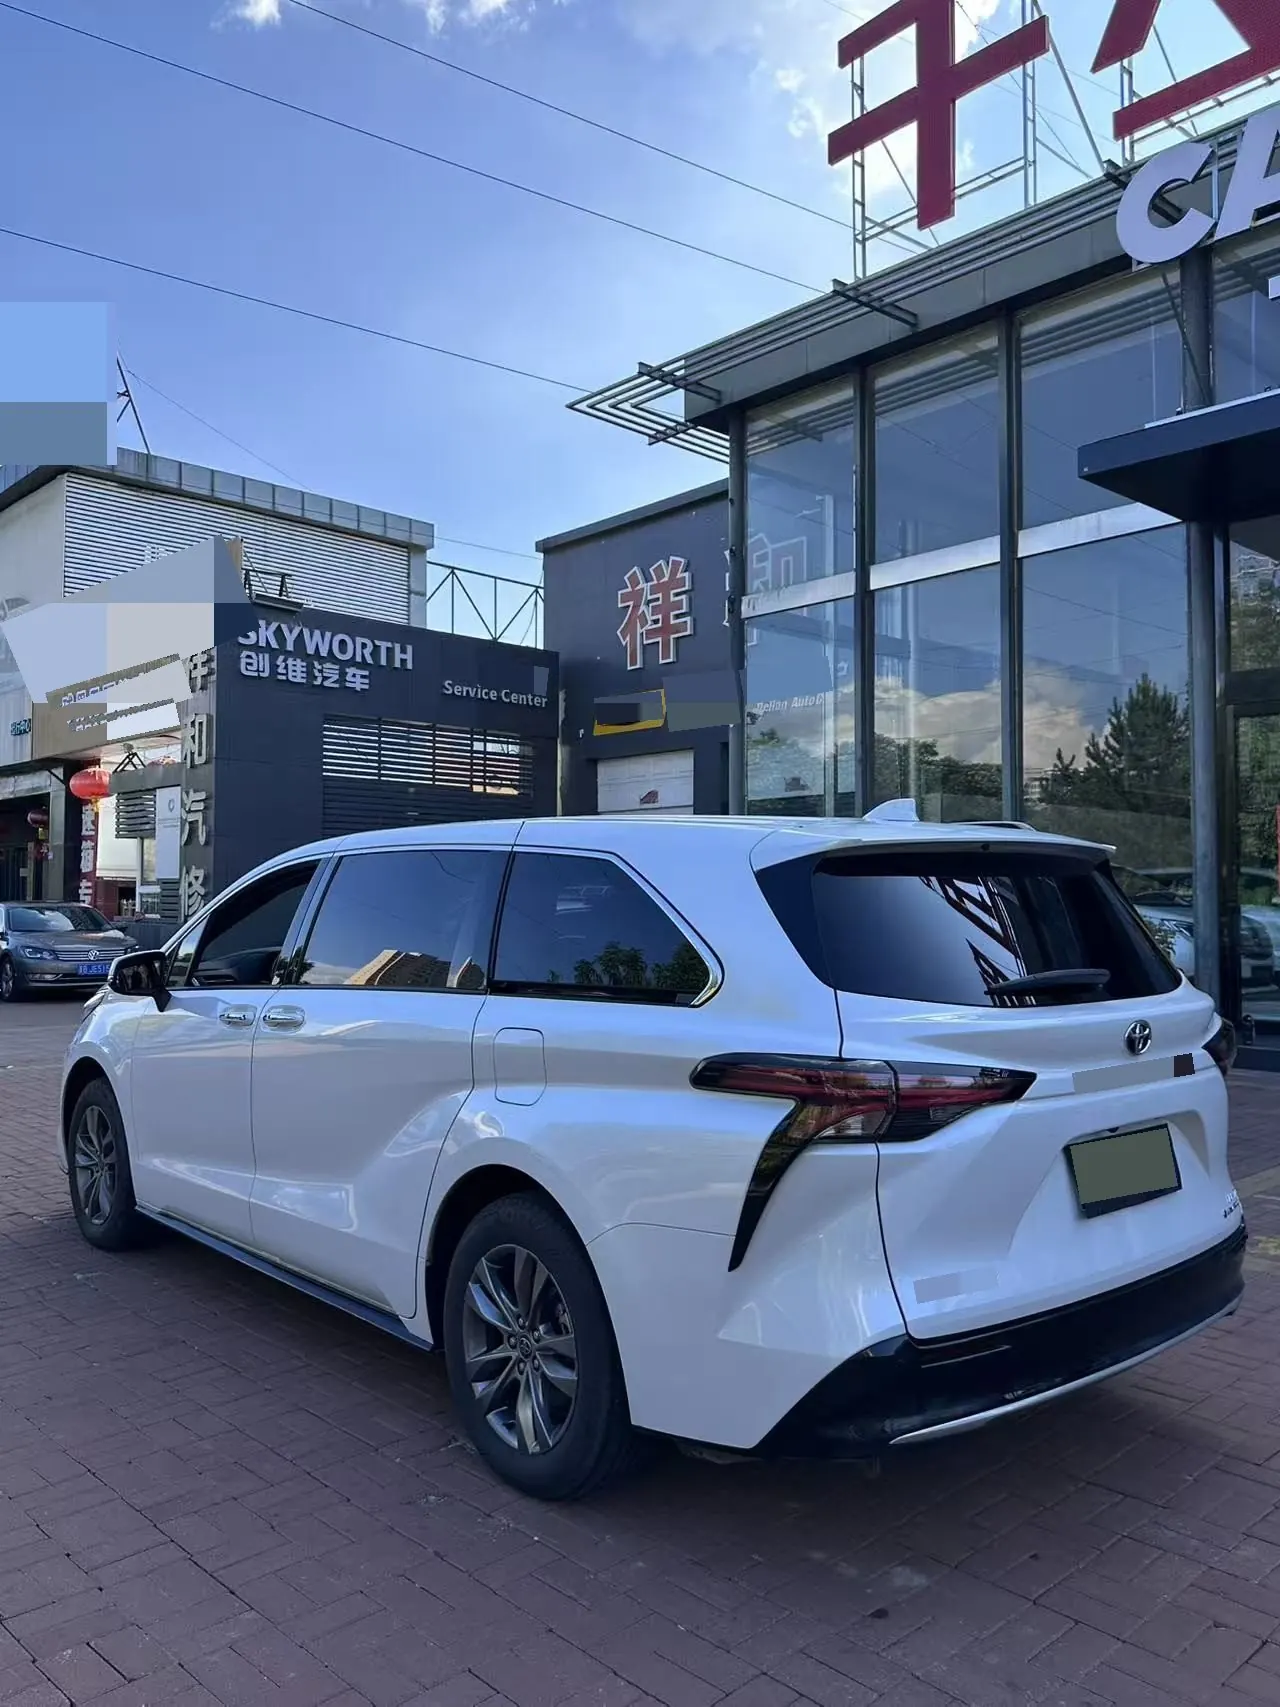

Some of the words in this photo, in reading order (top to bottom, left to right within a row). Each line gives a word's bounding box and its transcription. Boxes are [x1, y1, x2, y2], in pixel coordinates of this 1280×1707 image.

[239, 650, 370, 691] 创维汽车
[443, 680, 498, 701] Service
[501, 689, 548, 708] Center
